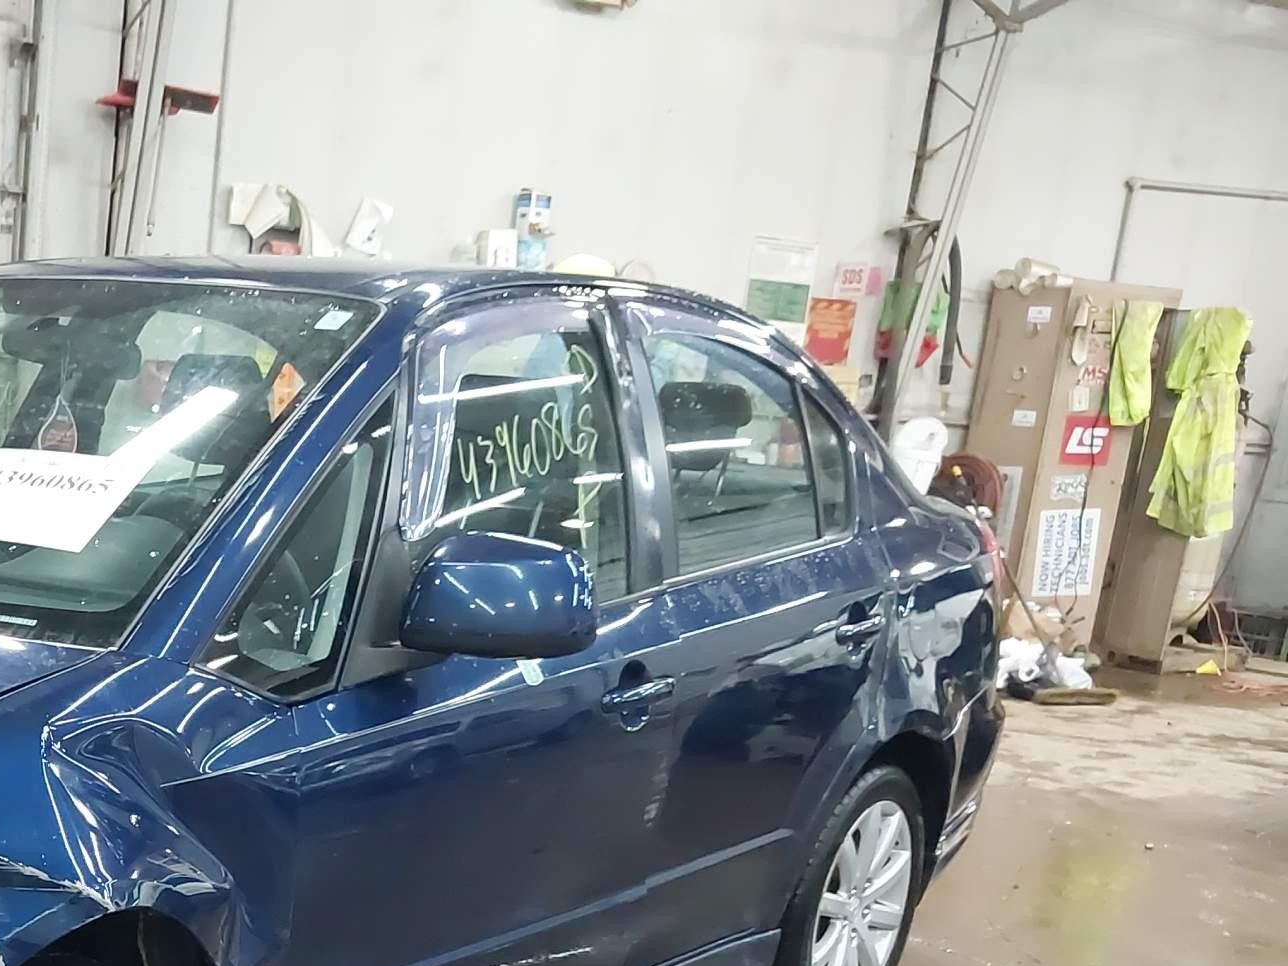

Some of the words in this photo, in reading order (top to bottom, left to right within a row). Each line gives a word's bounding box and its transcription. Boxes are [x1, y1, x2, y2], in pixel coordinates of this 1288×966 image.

[841, 268, 864, 286] SDS
[456, 400, 600, 501] 43960865
[1041, 514, 1056, 558] HIRING
[1050, 512, 1068, 593] TECHNICIANS
[1038, 561, 1050, 592] NOW
